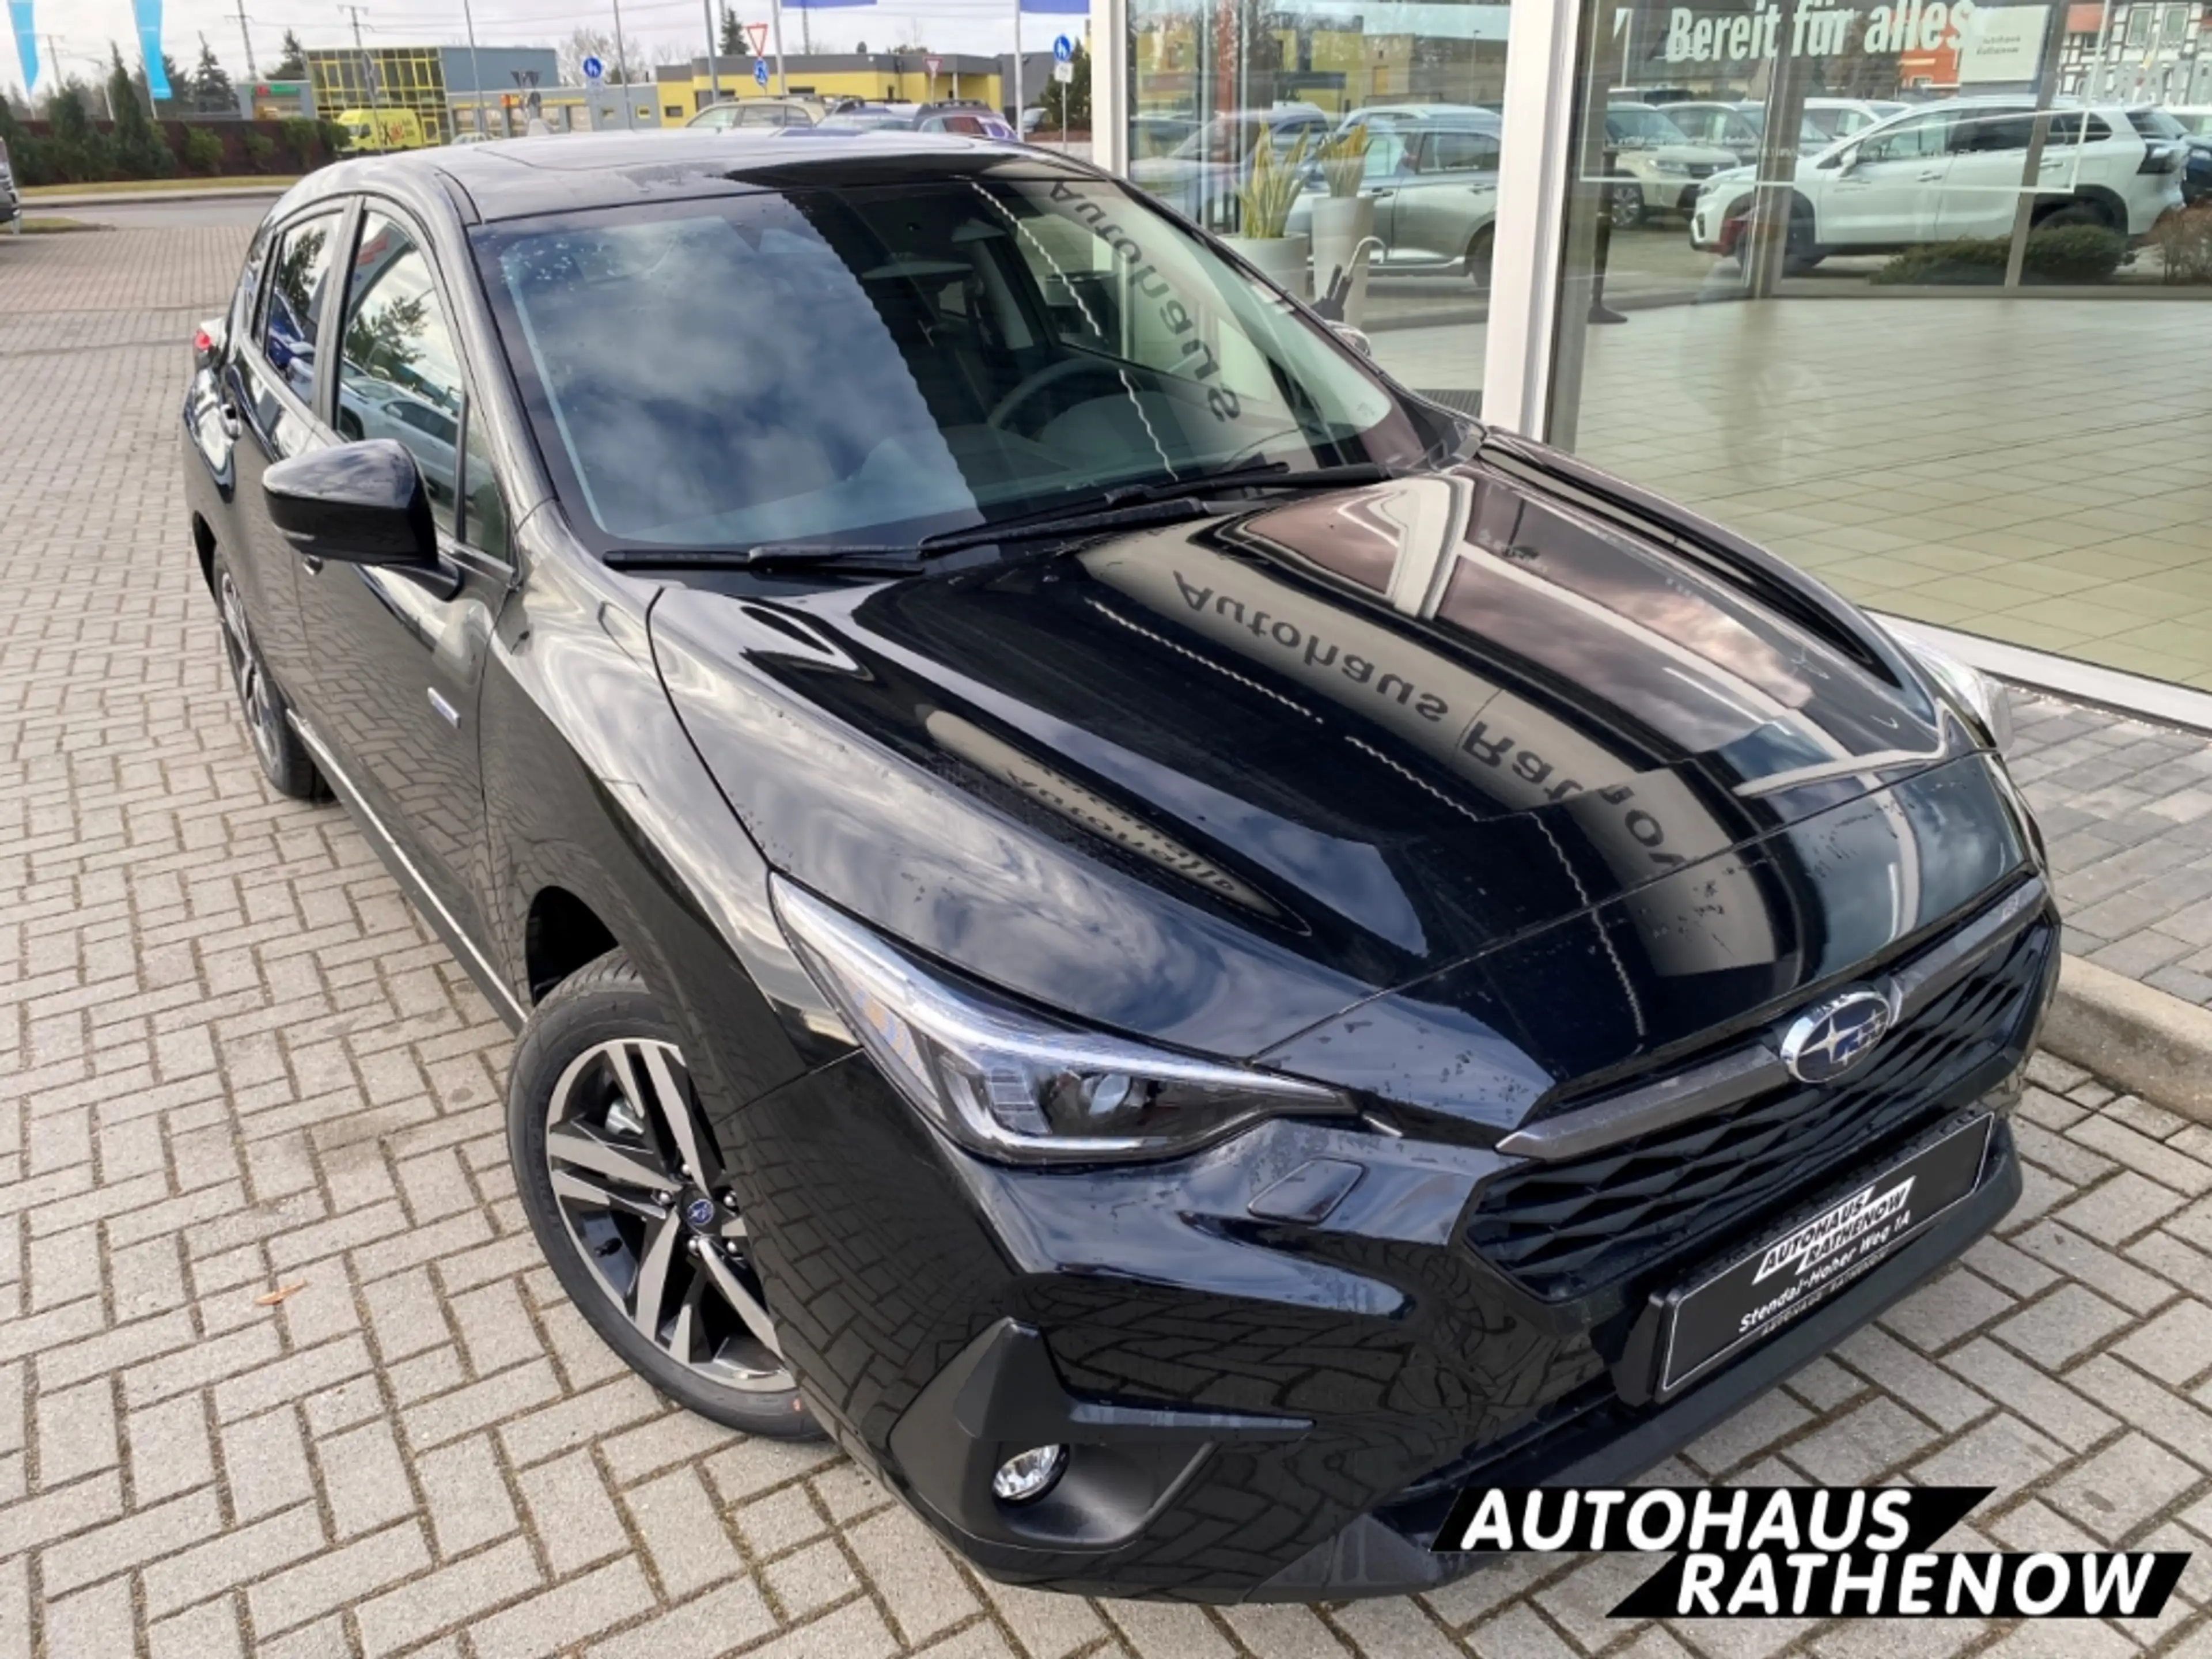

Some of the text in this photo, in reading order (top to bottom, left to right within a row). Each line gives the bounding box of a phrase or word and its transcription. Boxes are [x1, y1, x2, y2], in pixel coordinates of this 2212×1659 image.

[1666, 0, 1977, 63] Bereit für alles
[1761, 1195, 1866, 1275] AUTOHAUS
[1808, 1185, 1908, 1264] RATHENOW
